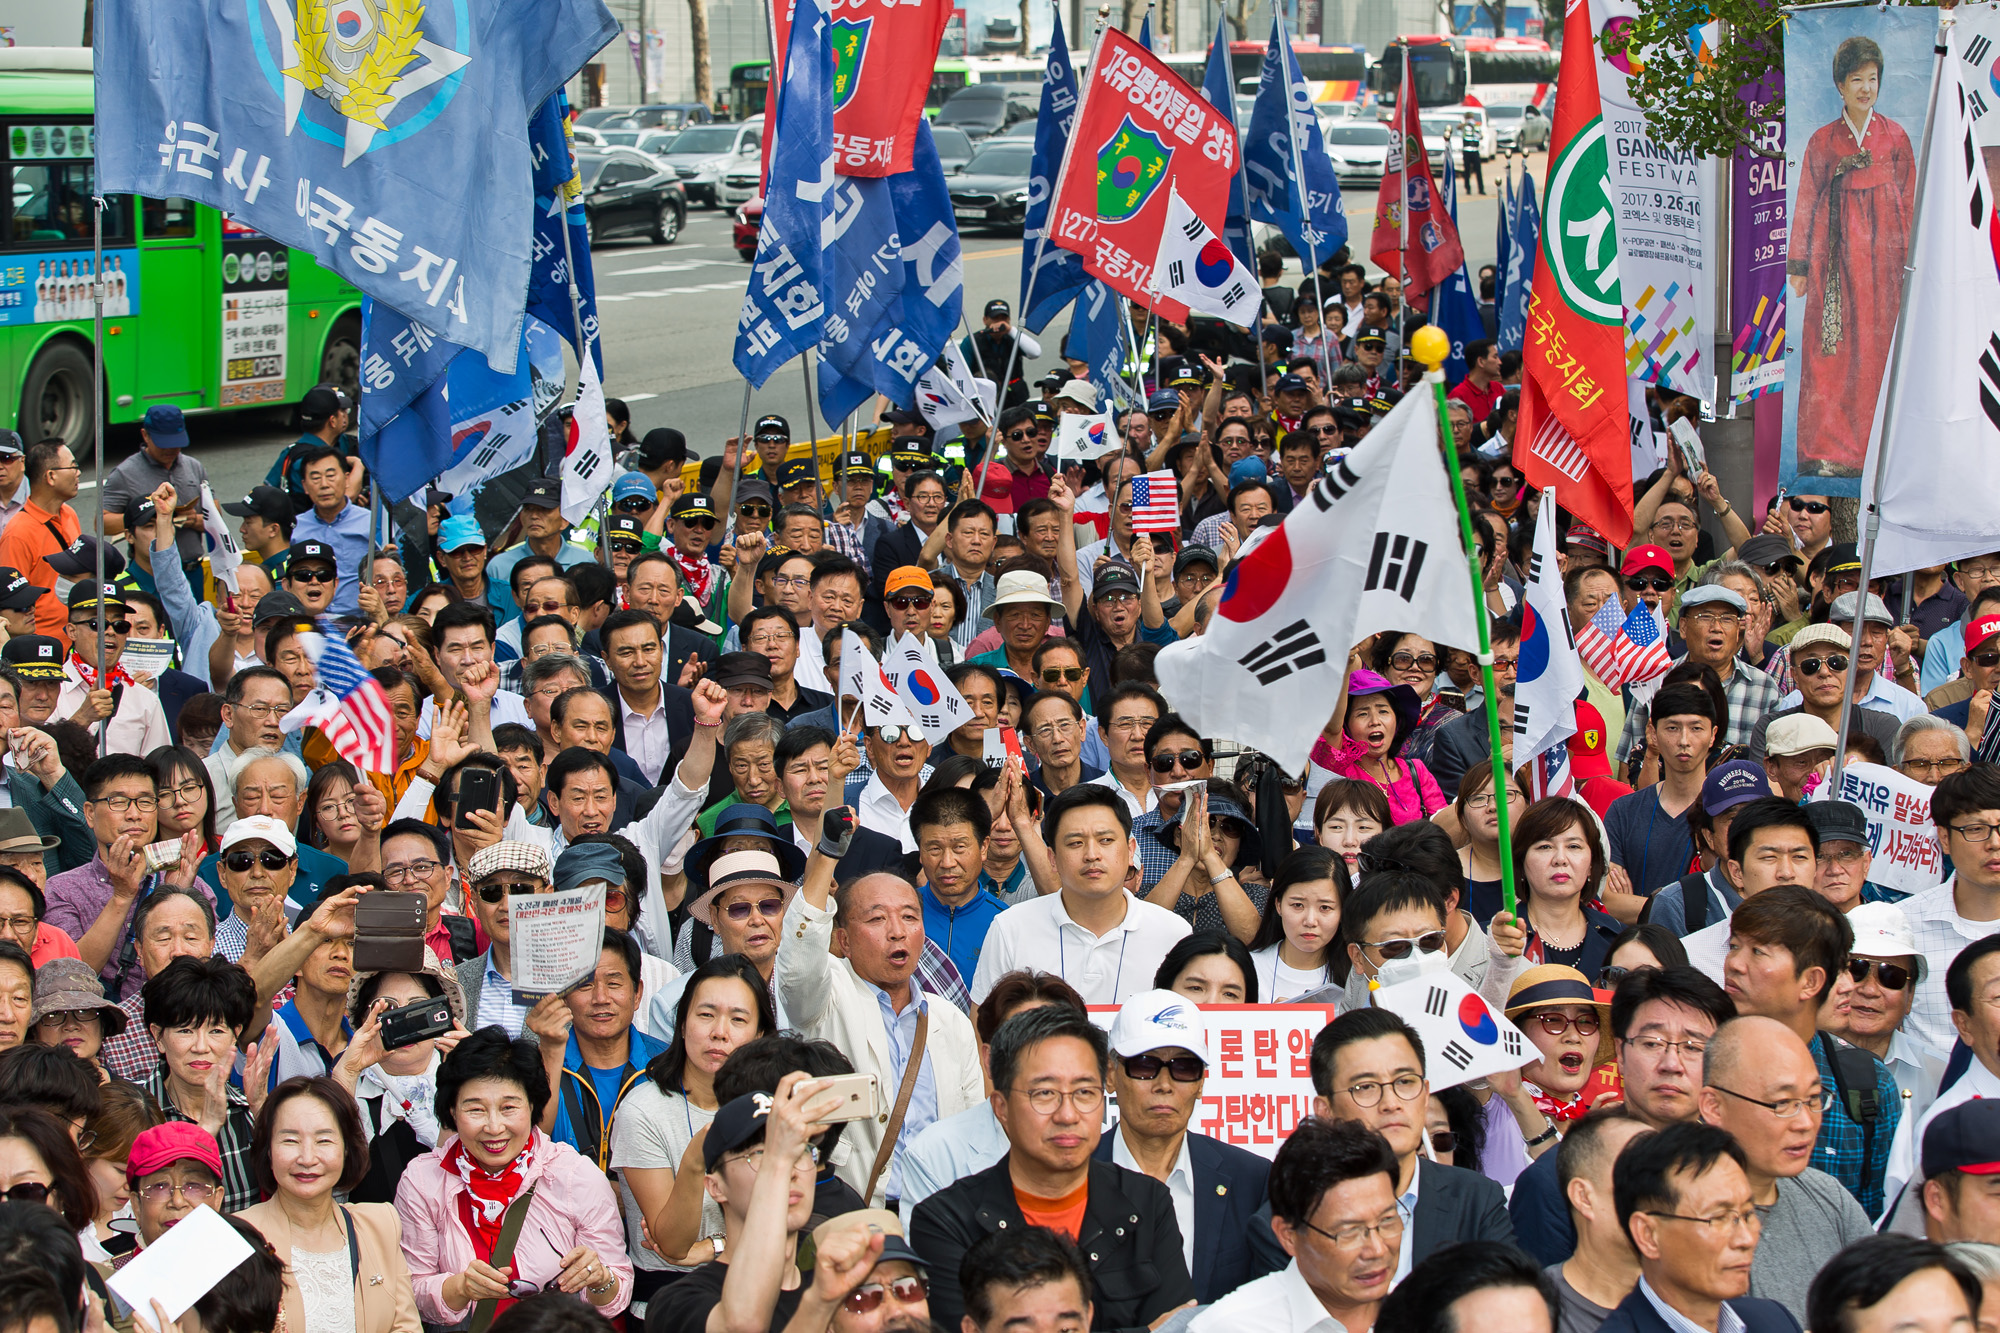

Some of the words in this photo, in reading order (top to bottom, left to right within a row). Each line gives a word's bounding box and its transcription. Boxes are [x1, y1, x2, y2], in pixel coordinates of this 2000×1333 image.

[1614, 121, 1641, 134] 2017
[1749, 161, 1786, 196] SAL
[1622, 210, 1650, 222] 코엑스
[1775, 206, 1786, 221] 9.
[1755, 244, 1774, 262] 9.29
[1718, 769, 1742, 787] RETIREES
[1742, 769, 1758, 782] NIGHT
[1893, 792, 1936, 827] 말살
